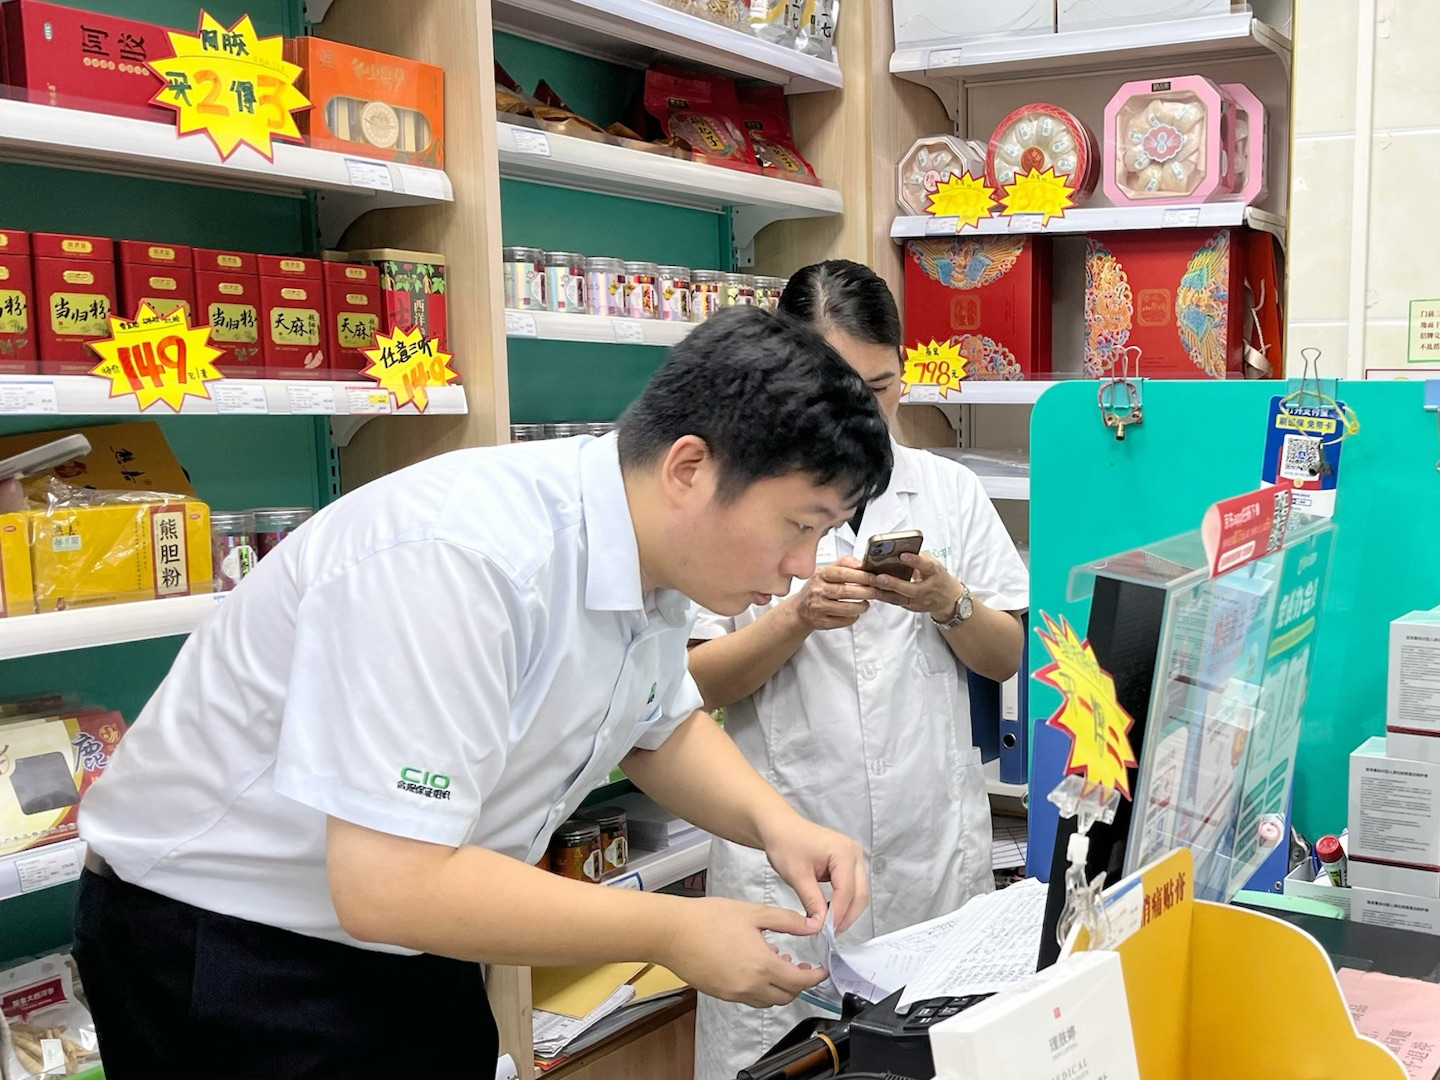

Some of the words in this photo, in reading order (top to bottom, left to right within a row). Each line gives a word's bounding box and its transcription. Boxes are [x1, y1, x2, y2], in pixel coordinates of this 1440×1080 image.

[212, 307, 257, 332] 当归粉
[274, 313, 308, 338] 天麻
[341, 317, 370, 341] 天麻
[117, 335, 187, 391] 149
[914, 361, 950, 386] 798
[402, 356, 446, 400] 149
[159, 519, 182, 589] 熊胆粉
[400, 766, 450, 789] CIO
